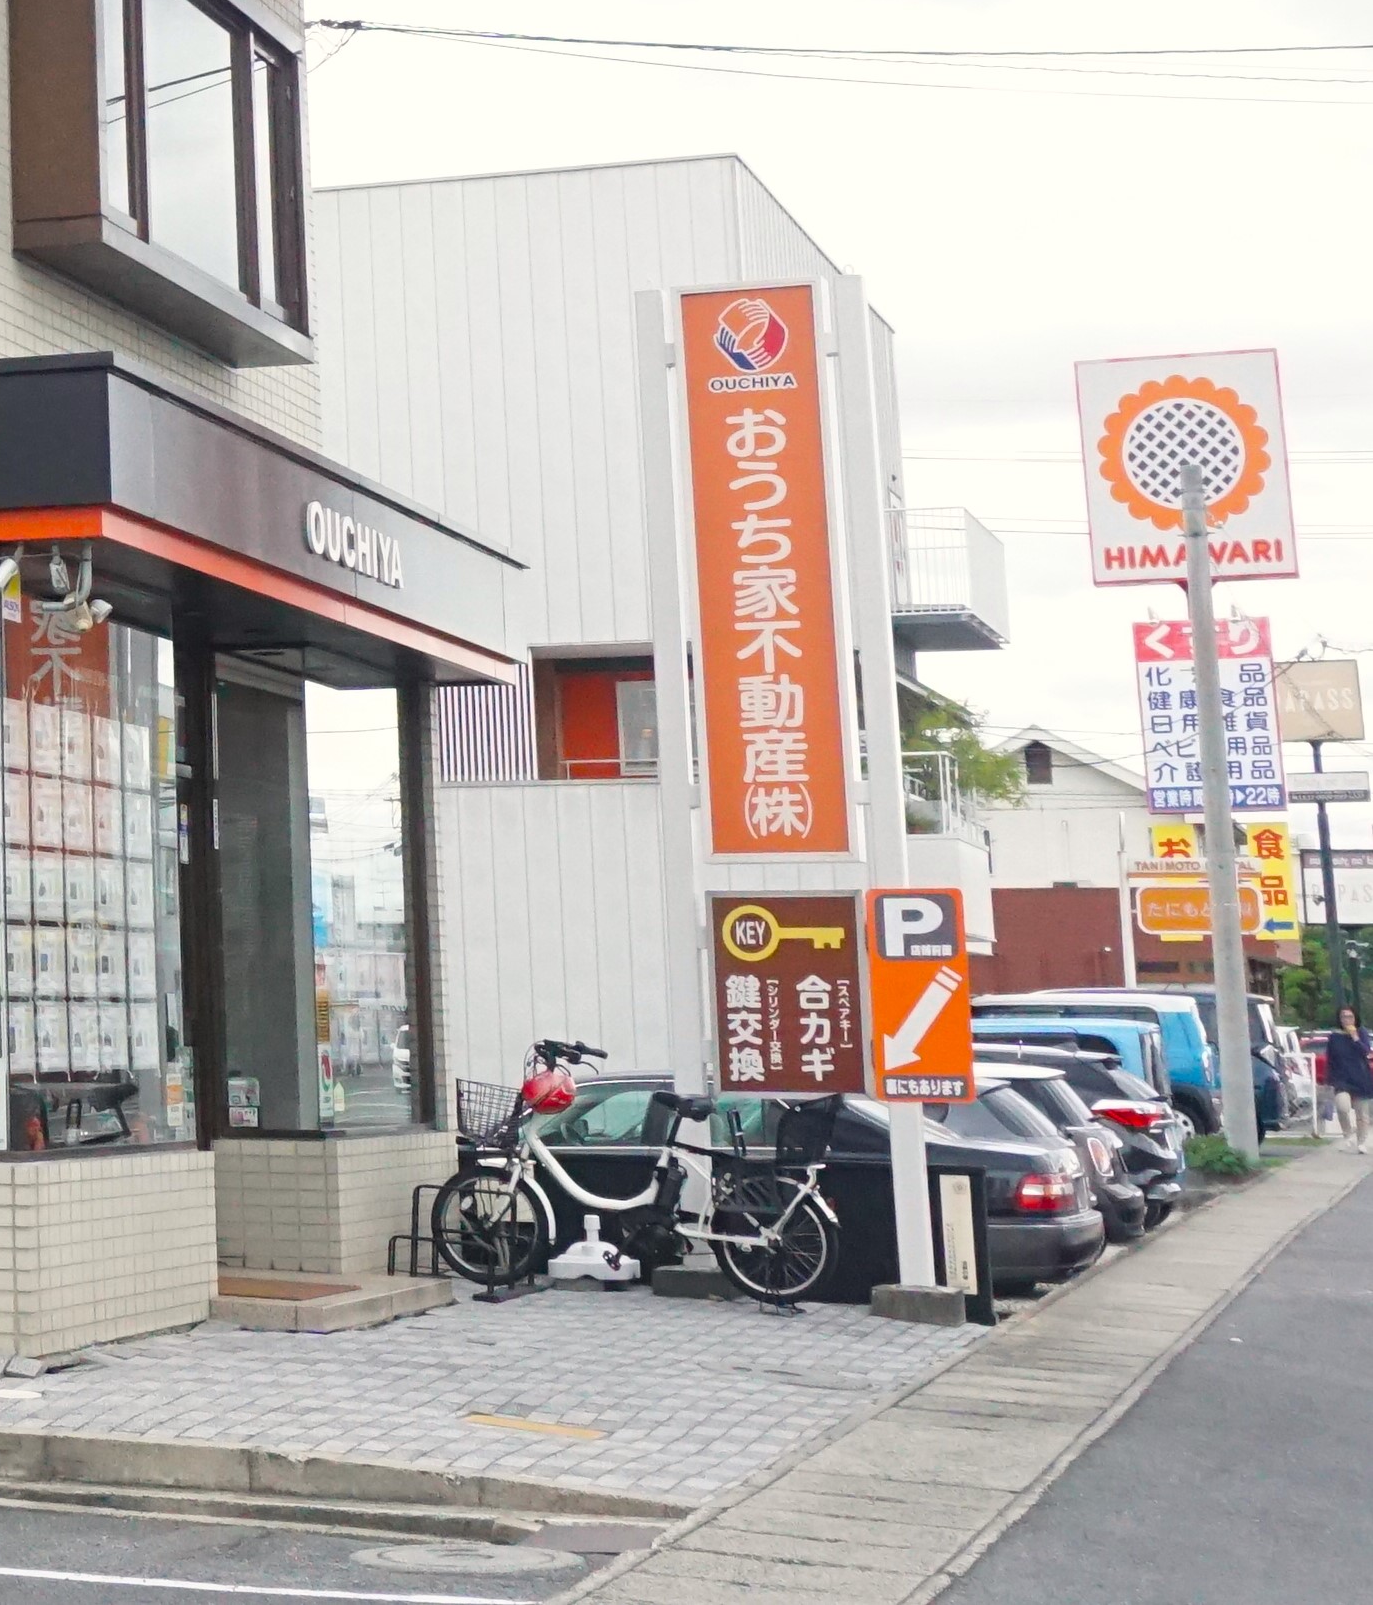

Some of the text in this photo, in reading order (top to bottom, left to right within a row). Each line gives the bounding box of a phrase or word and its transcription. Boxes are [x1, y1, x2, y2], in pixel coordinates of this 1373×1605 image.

[706, 373, 798, 392] OUCHIYA
[306, 500, 404, 589] OUCHIYA
[1152, 735, 1273, 758] ベビ用品
[1134, 860, 1201, 872] TANIMOTO
[1252, 828, 1289, 906] 食品
[735, 920, 766, 946] KEY
[882, 897, 944, 957] P
[725, 974, 766, 1082] 鍵交換
[796, 974, 836, 1082] 合カギ
